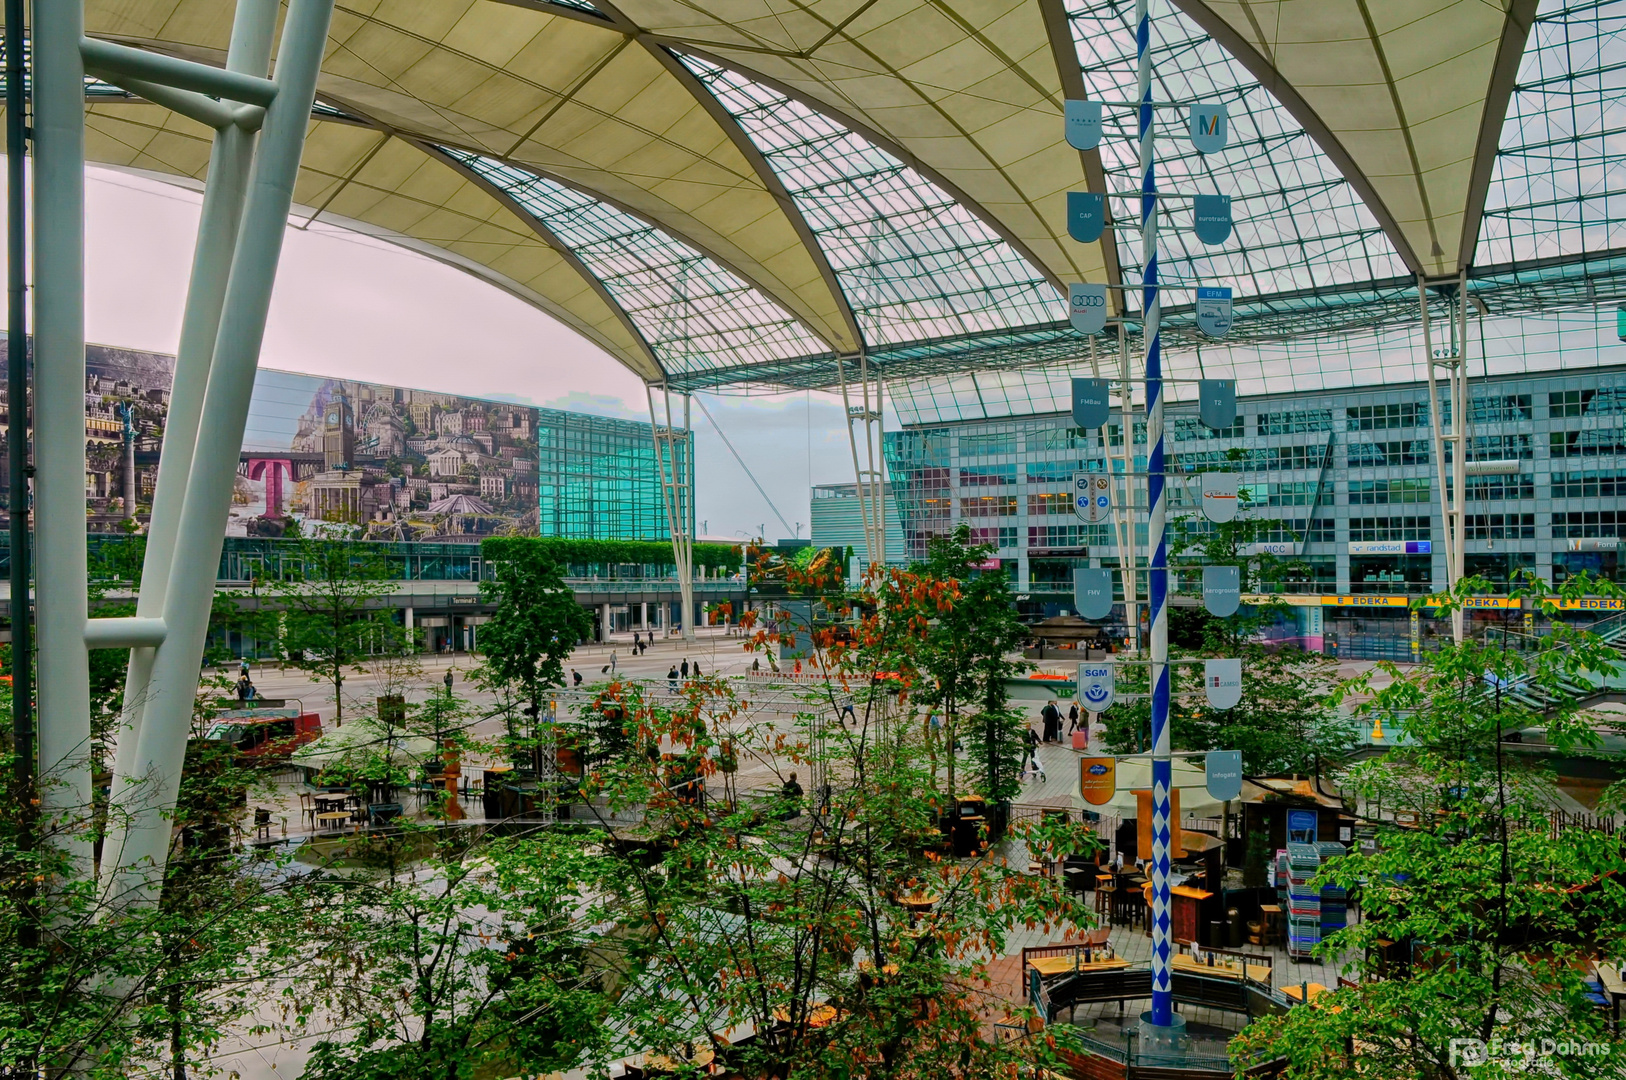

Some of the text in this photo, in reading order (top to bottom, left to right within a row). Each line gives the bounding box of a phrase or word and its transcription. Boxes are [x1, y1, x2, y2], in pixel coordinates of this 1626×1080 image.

[1199, 115, 1220, 135] M
[1264, 545, 1285, 553] MCC
[1366, 544, 1401, 552] randstad
[1085, 669, 1107, 677] SGM
